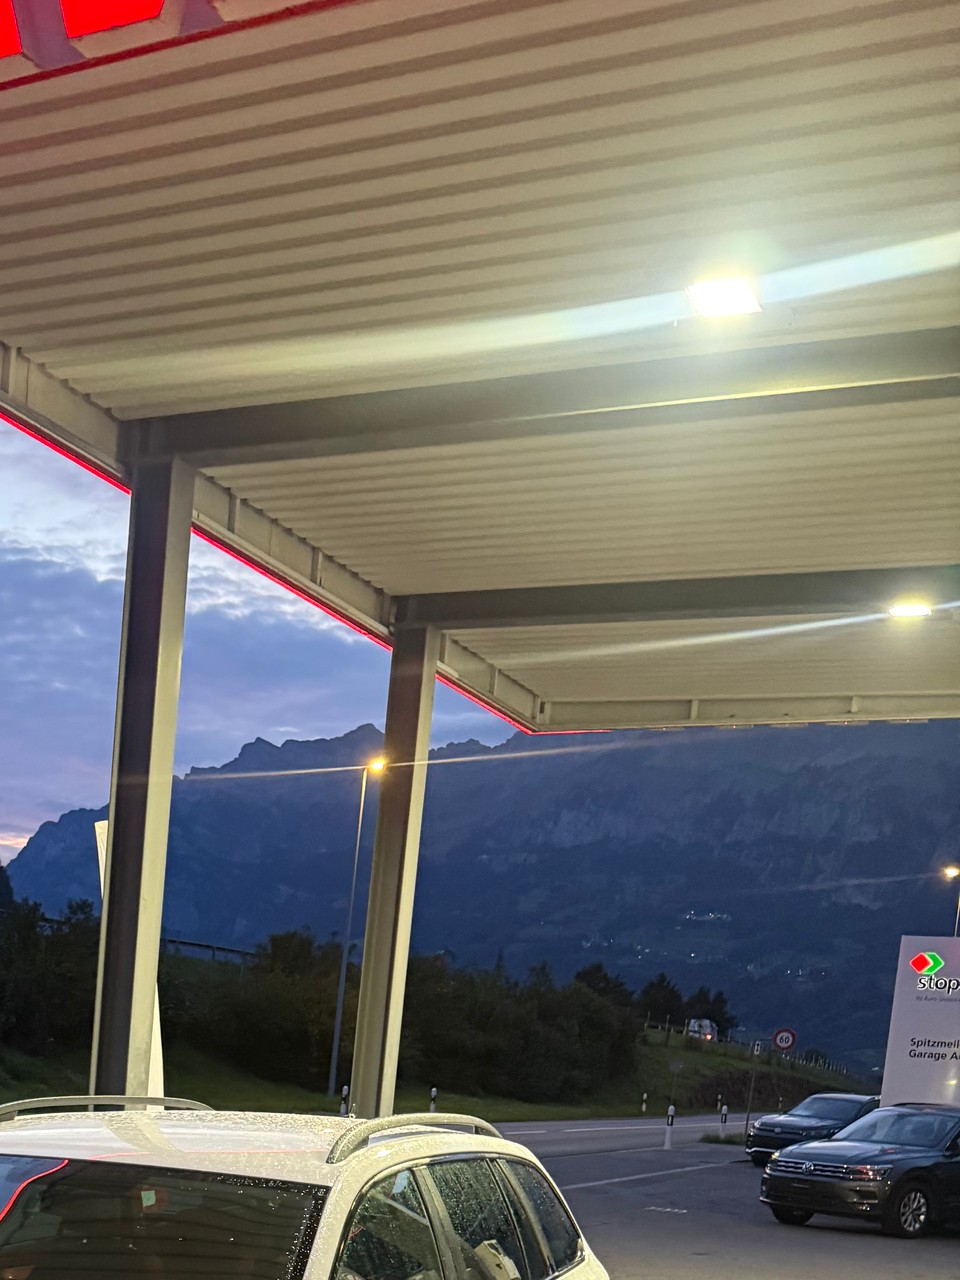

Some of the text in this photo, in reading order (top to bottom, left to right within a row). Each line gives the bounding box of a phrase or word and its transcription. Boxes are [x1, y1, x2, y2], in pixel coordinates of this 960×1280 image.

[779, 1035, 790, 1044] 60
[908, 1049, 960, 1061] Garage A
